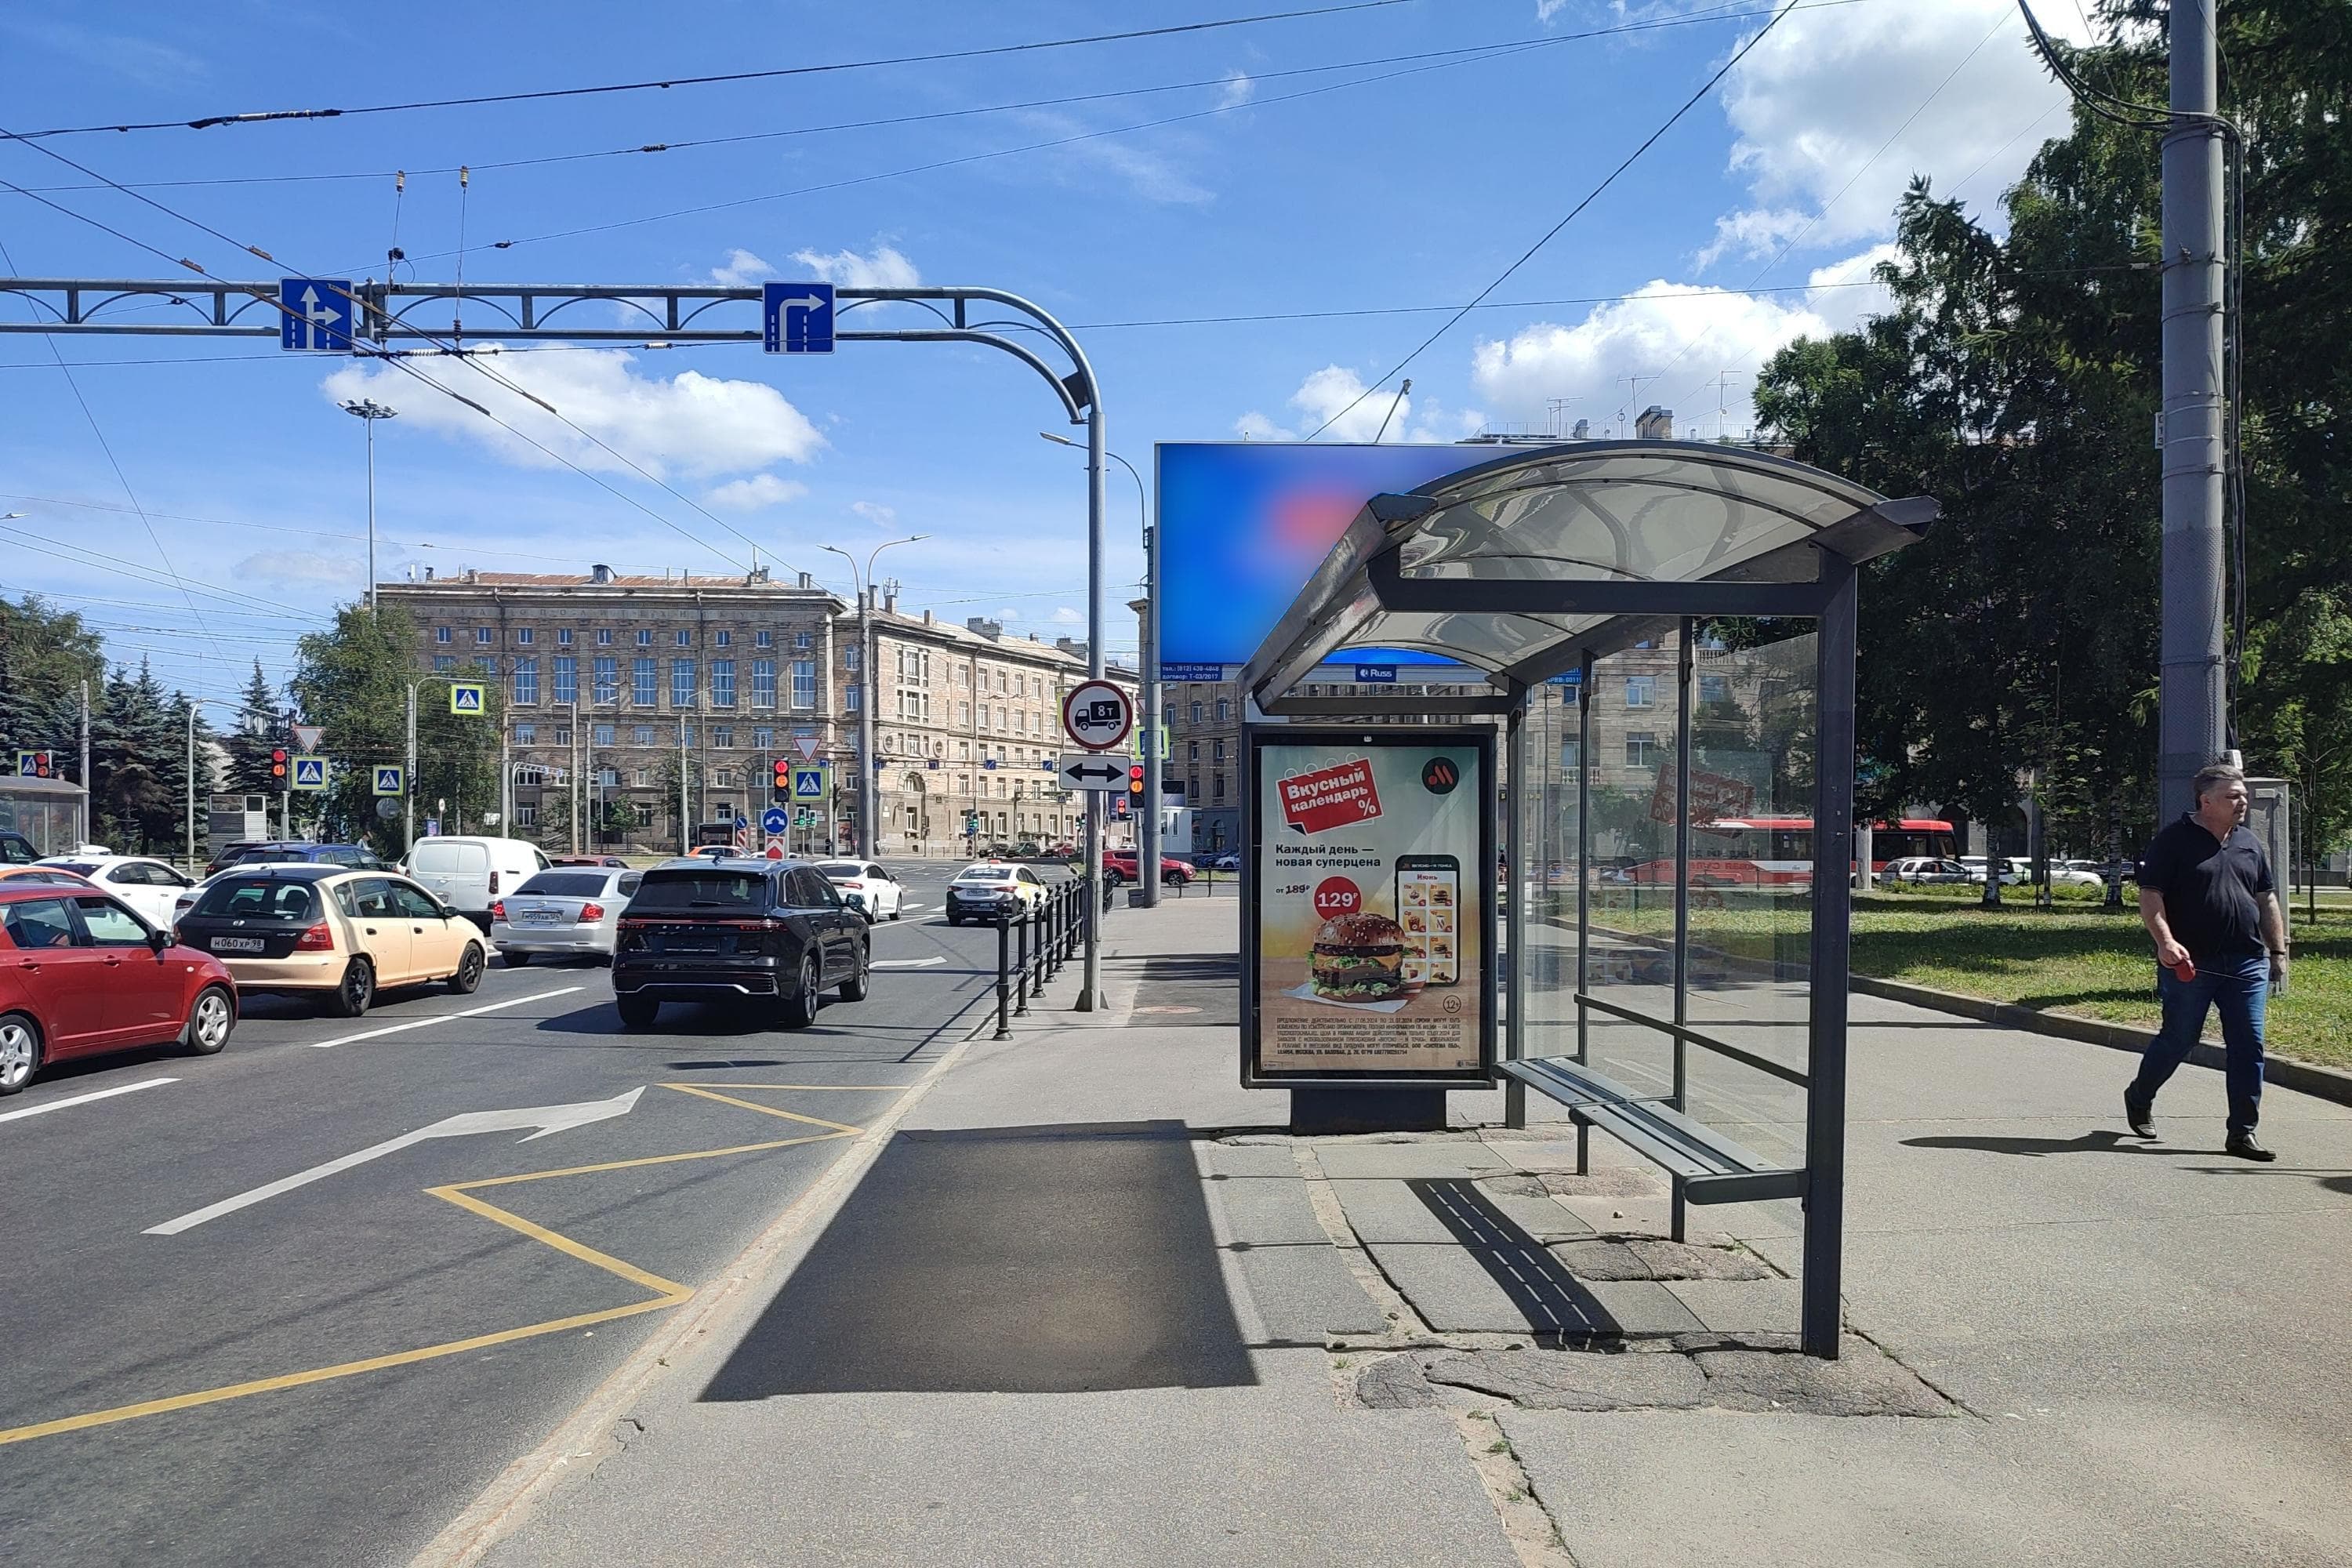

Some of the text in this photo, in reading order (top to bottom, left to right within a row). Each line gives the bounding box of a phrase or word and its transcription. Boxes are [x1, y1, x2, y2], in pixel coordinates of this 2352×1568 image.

[1370, 669, 1392, 677] Russ
[1287, 768, 1366, 800] Вкусный
[1291, 786, 1368, 813] календарь
[1358, 797, 1377, 816] %
[1276, 844, 1326, 855] Каждый
[1328, 846, 1358, 855] день
[1276, 858, 1381, 868] новая суперцена
[1446, 1000, 1460, 1009] 12+
